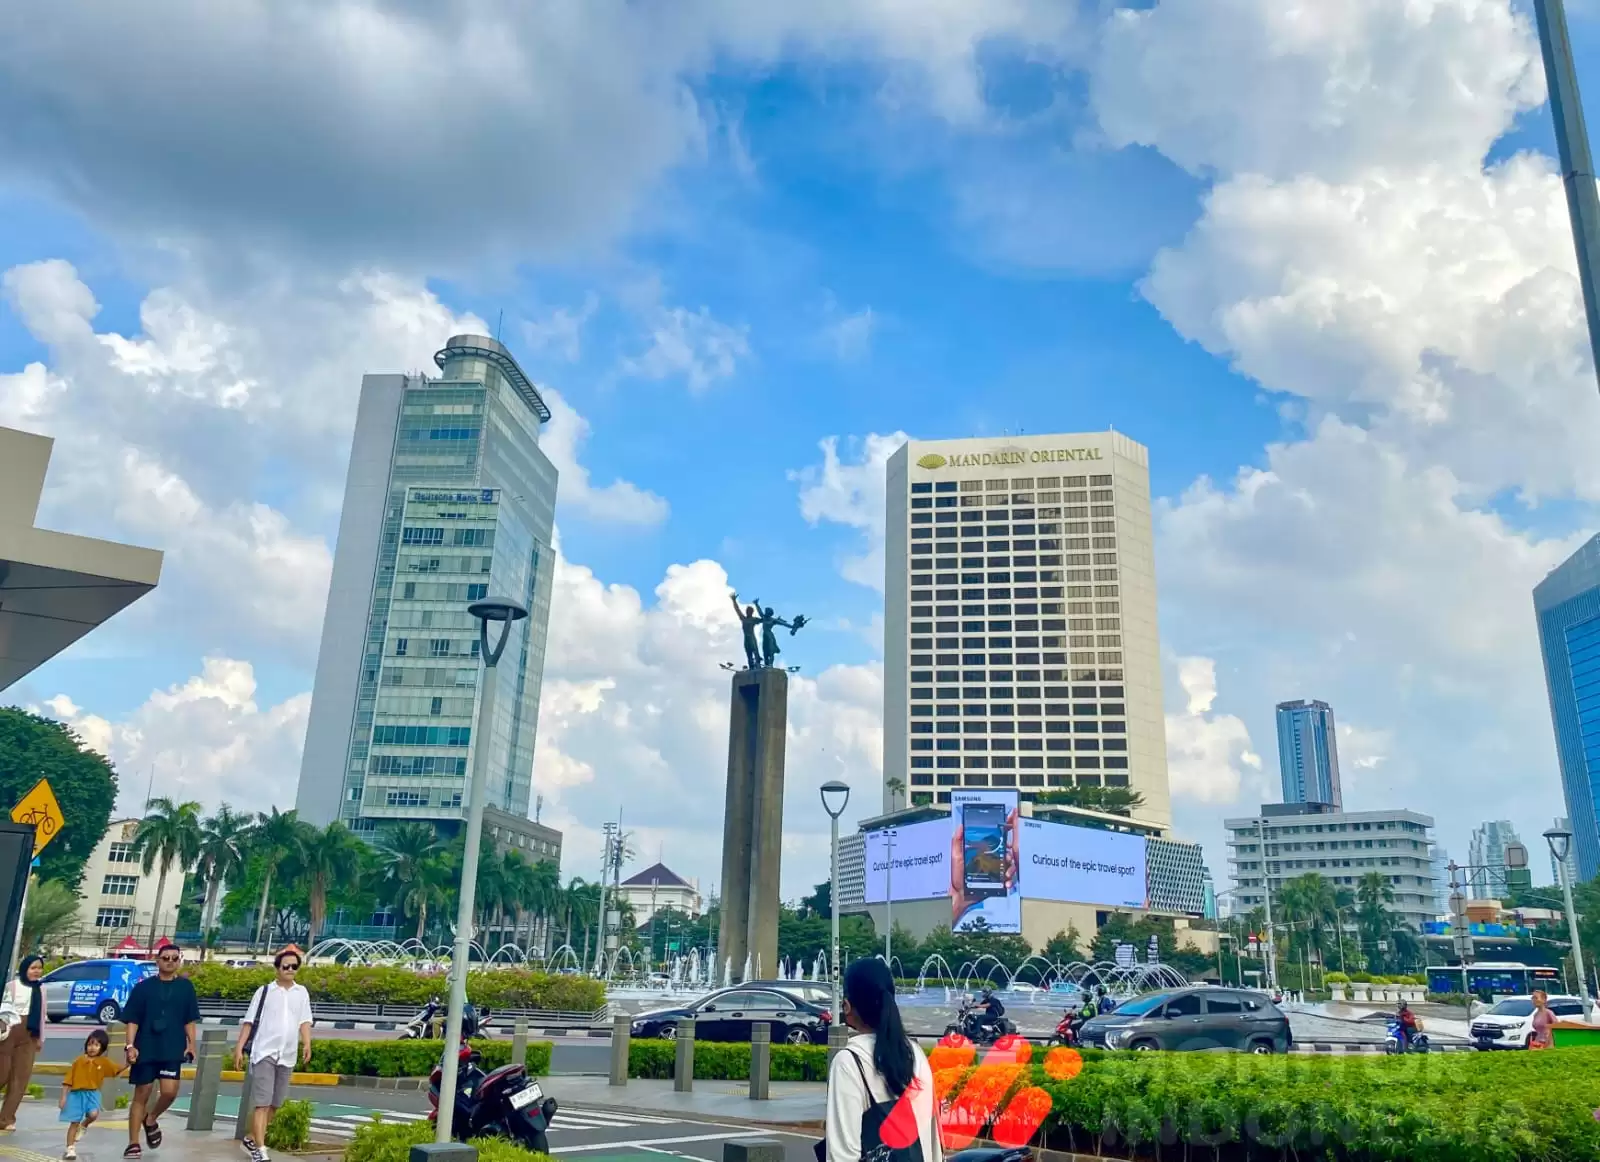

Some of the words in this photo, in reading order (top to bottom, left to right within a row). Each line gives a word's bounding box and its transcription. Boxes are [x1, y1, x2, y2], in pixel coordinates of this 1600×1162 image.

[949, 452, 1026, 467] MANDARIN
[1030, 448, 1104, 463] ORIENTAL
[1032, 853, 1060, 868] Curious
[1061, 856, 1068, 869] of
[1069, 858, 1081, 870] the
[1082, 859, 1097, 874] epic
[1098, 862, 1117, 874] travel
[1118, 865, 1136, 878] spot?
